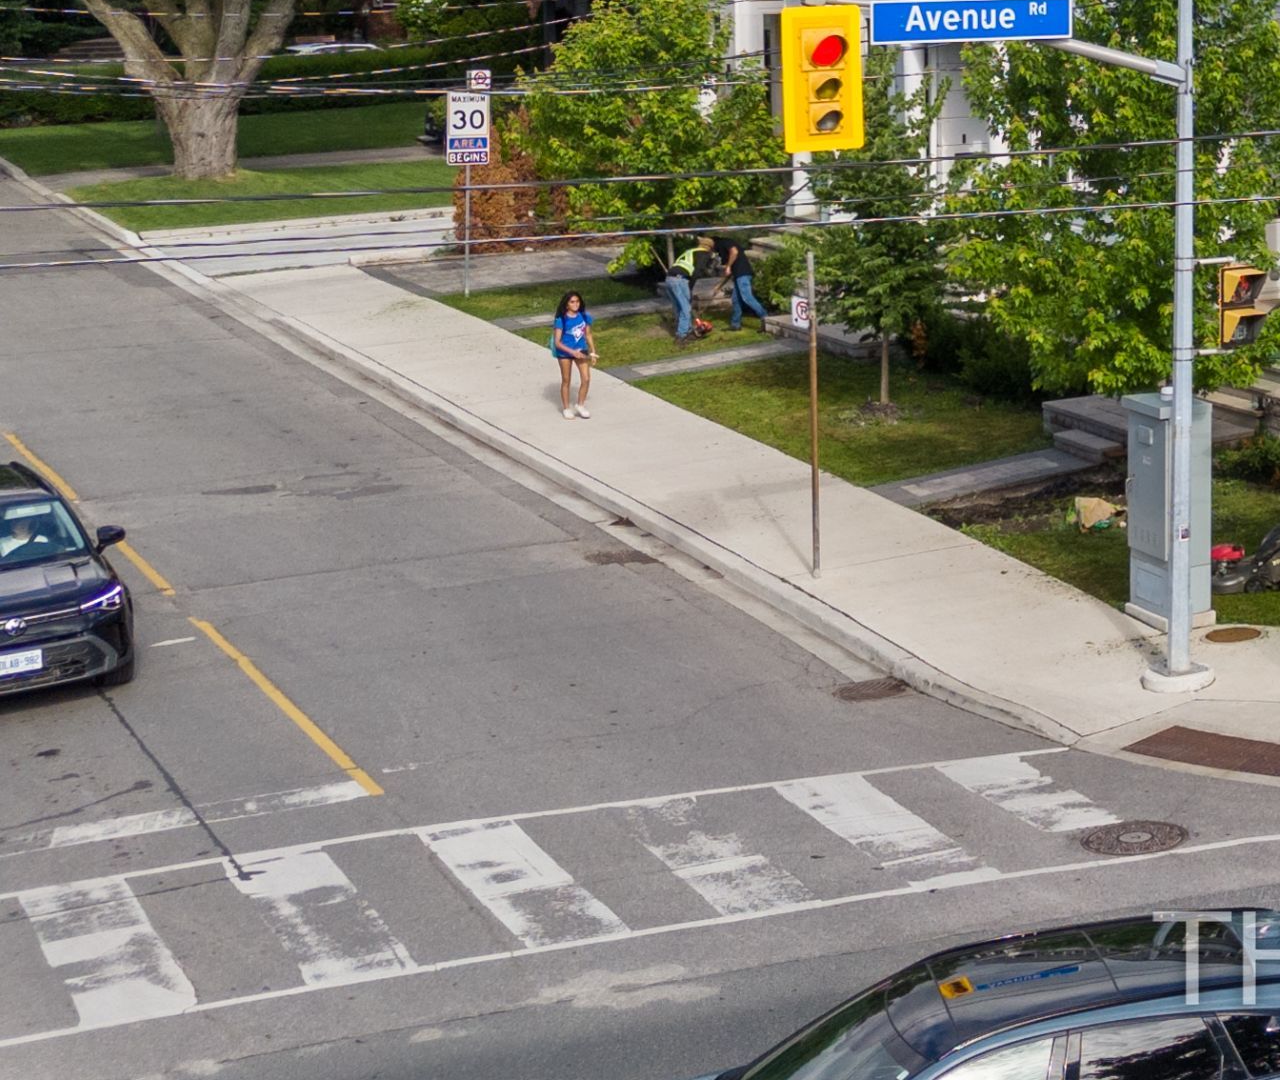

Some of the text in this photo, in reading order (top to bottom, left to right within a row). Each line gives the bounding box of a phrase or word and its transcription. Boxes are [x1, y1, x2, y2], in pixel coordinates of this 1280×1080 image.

[905, 1, 1047, 32] Avenue Rd
[451, 95, 486, 103] MAXIMUM
[452, 109, 485, 130] 30
[453, 140, 484, 149] AREA
[449, 153, 487, 163] BEGINS
